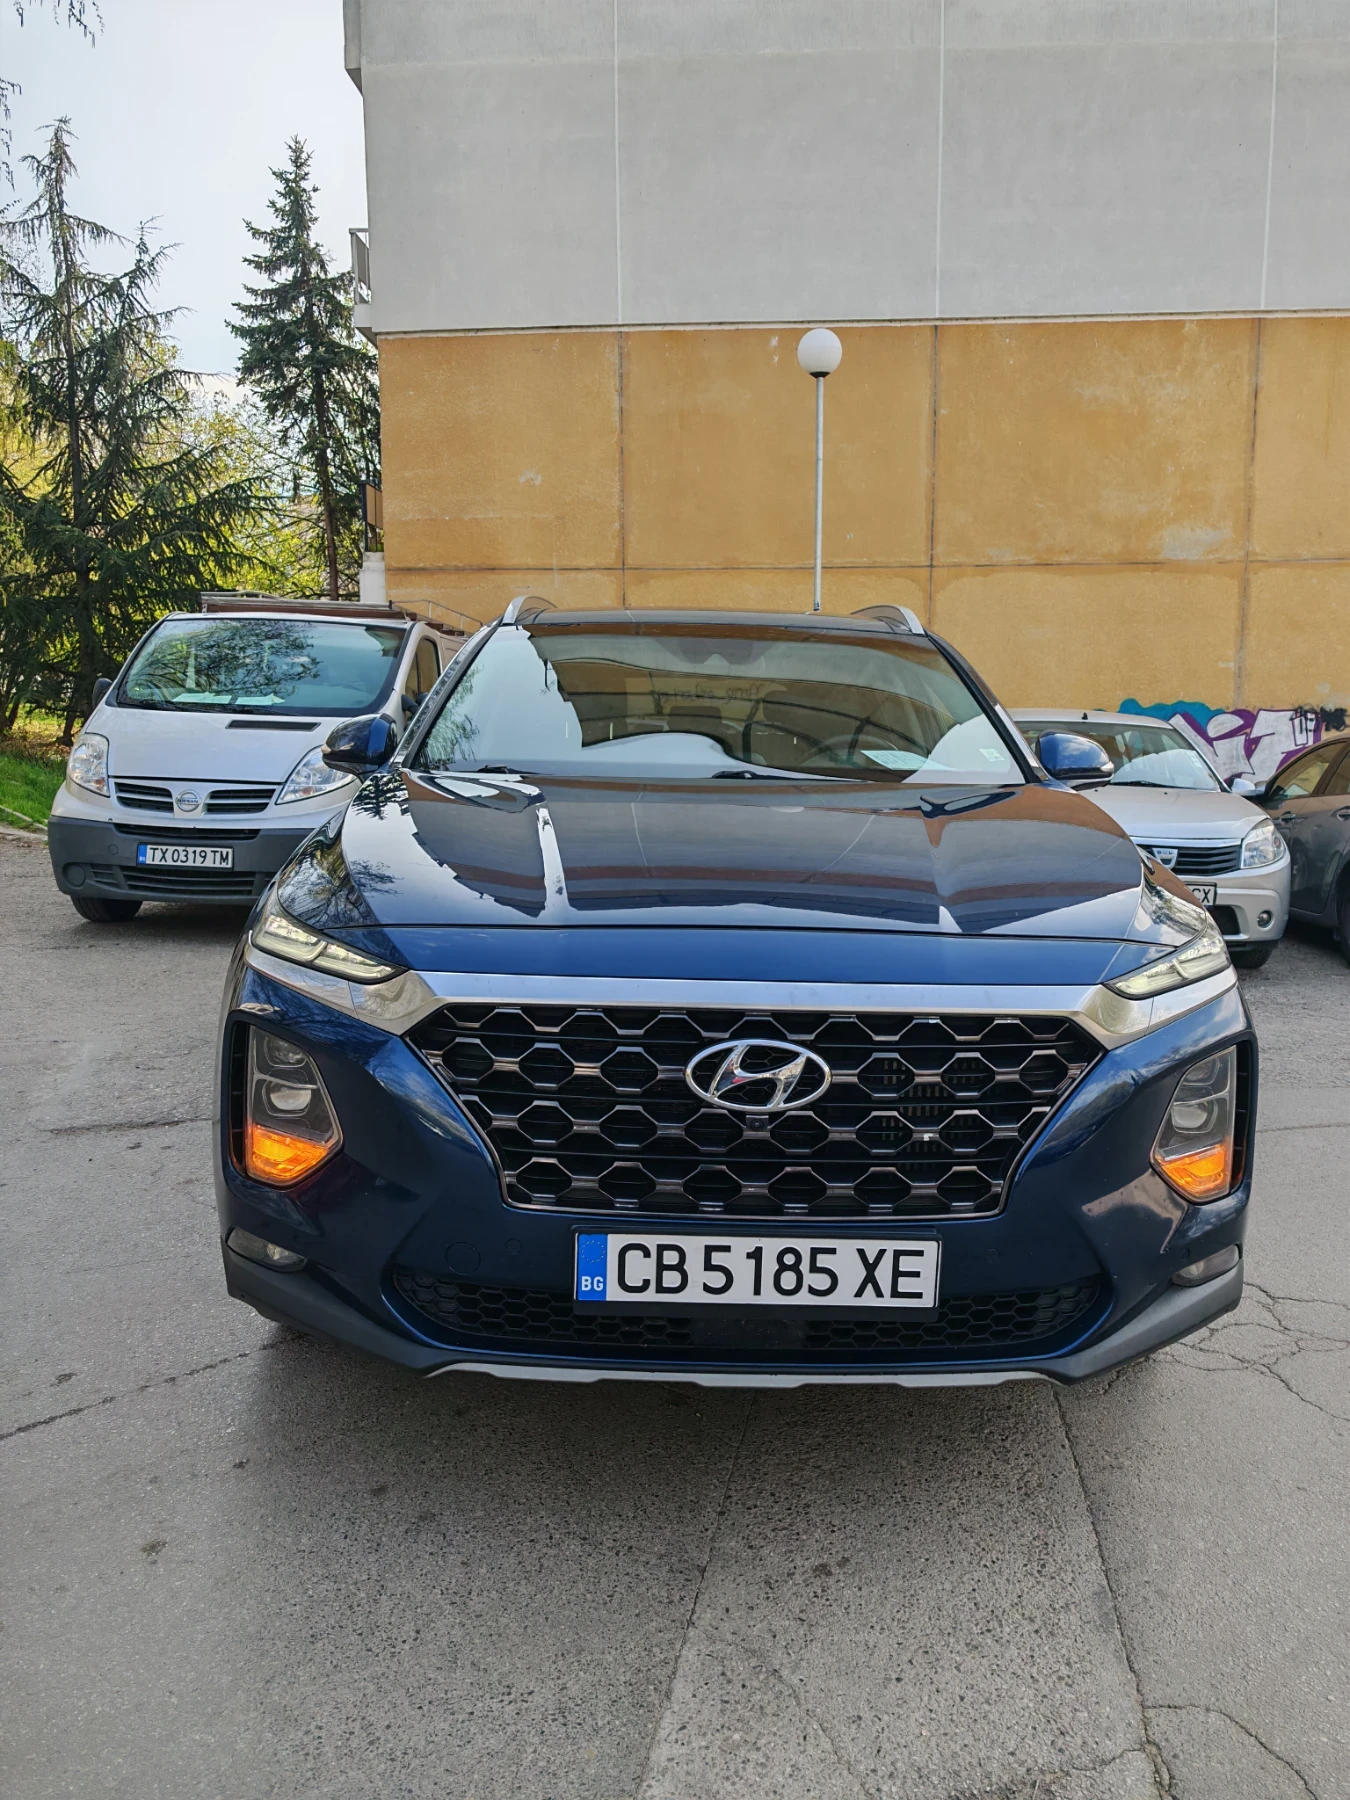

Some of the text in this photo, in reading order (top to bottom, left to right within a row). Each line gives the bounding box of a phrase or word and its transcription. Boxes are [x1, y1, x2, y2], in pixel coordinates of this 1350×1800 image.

[149, 847, 230, 866] TX 0319 TM
[617, 1242, 925, 1299] CB 5185 XE
[580, 1275, 604, 1291] BG
